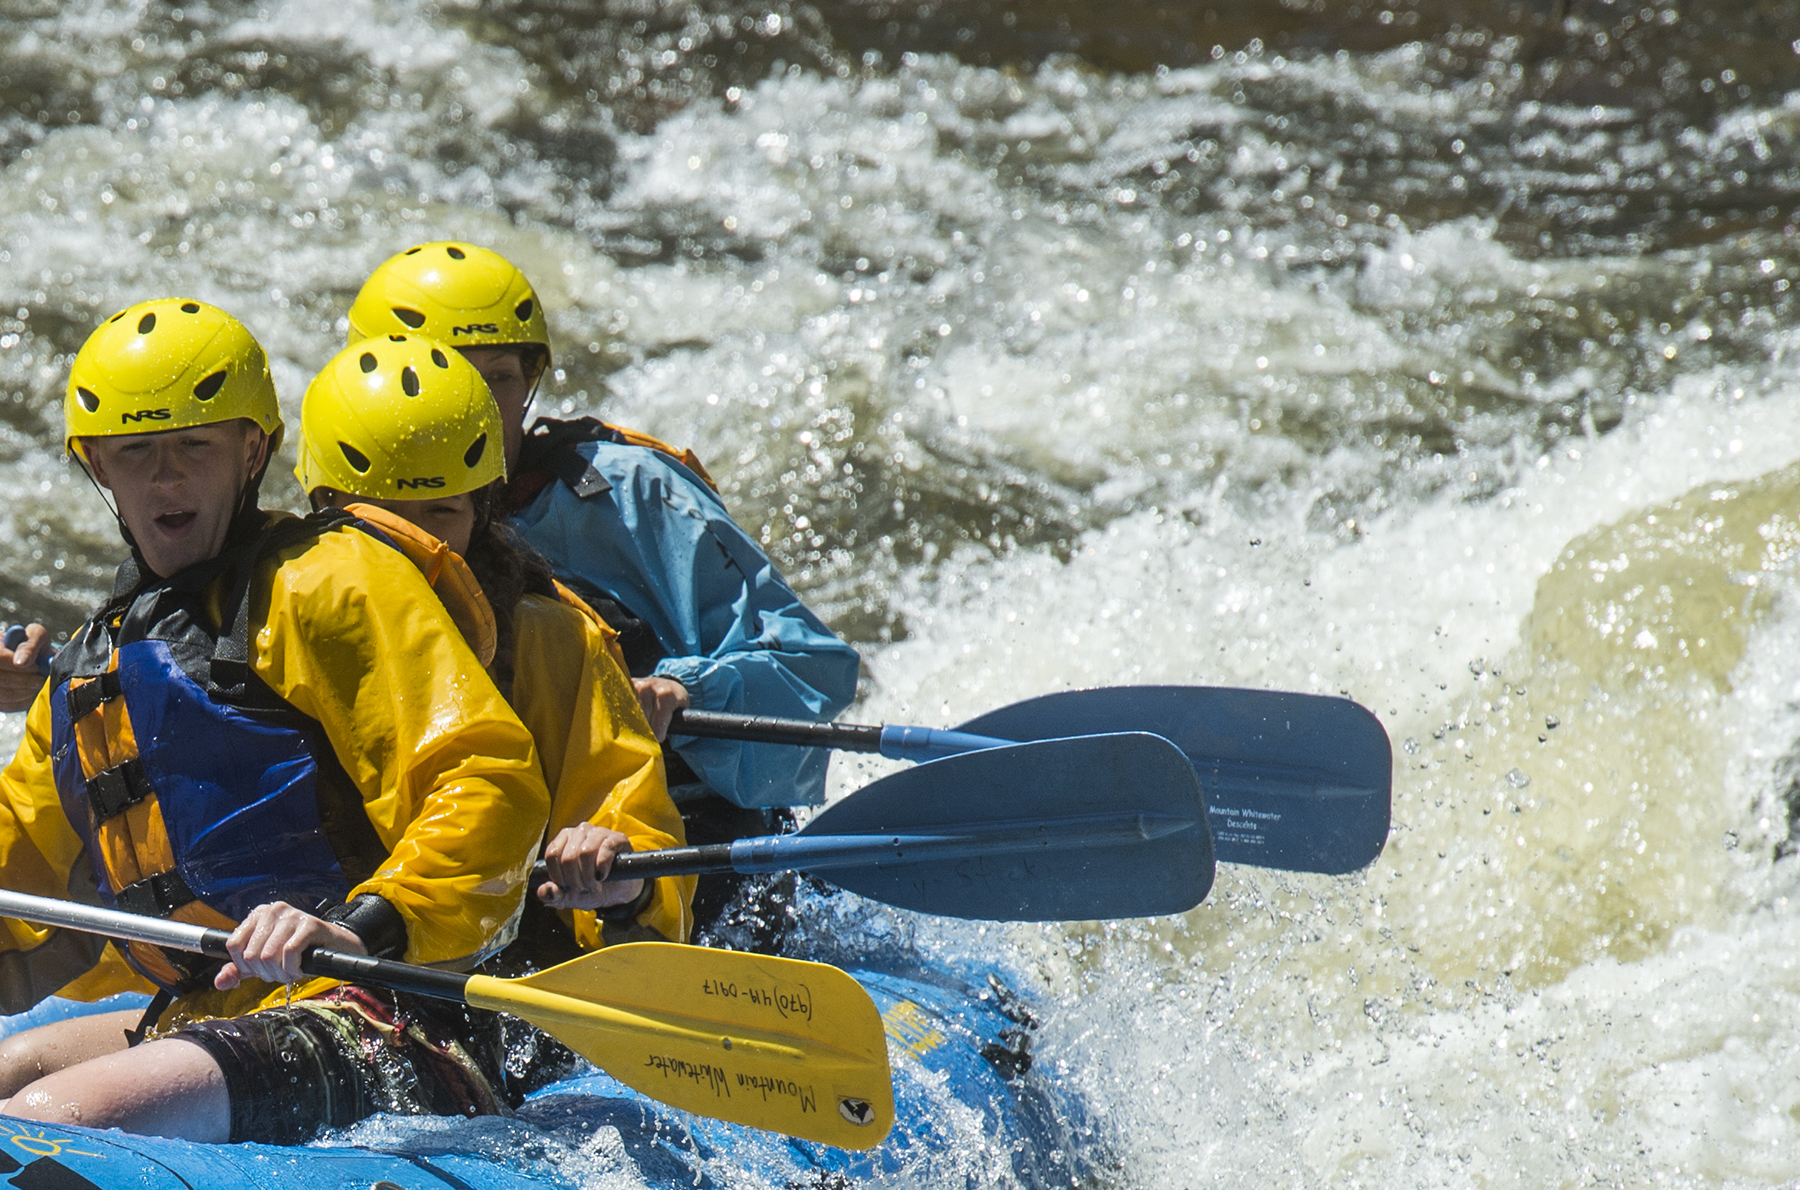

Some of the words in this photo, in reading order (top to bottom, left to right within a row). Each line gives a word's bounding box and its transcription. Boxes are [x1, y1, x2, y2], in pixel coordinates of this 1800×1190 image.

[452, 322, 499, 337] NRS
[121, 408, 172, 425] NRS
[397, 476, 446, 490] NRS
[1209, 805, 1240, 816] Mountain
[1242, 809, 1282, 821] Whitewater
[1227, 818, 1257, 830] Descents
[644, 1054, 731, 1098] Whitewater
[735, 1073, 817, 1114] Mountain
